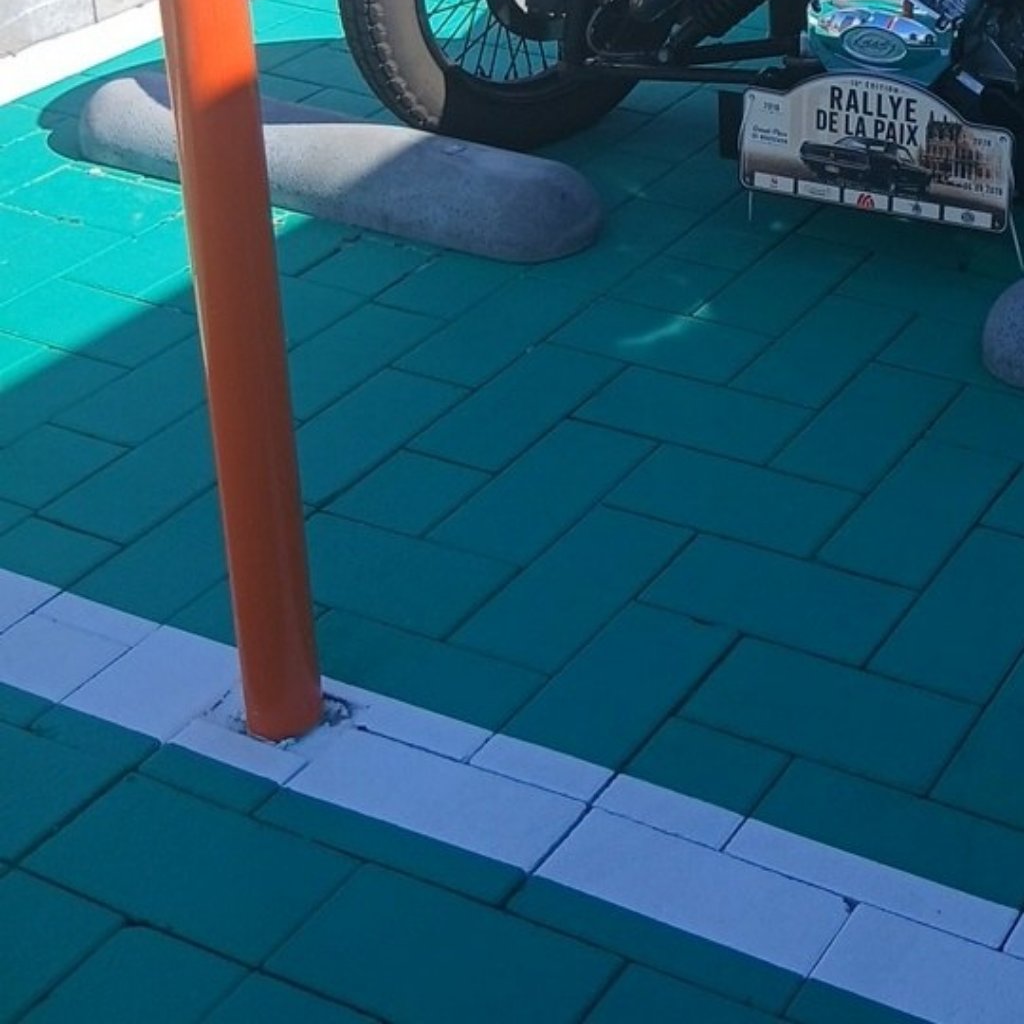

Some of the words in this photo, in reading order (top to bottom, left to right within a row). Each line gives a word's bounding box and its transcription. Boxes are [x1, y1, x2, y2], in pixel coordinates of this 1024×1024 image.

[830, 85, 917, 123] RALLYE
[816, 108, 839, 133] DE
[845, 113, 866, 137] LA
[874, 119, 918, 147] PAIX
